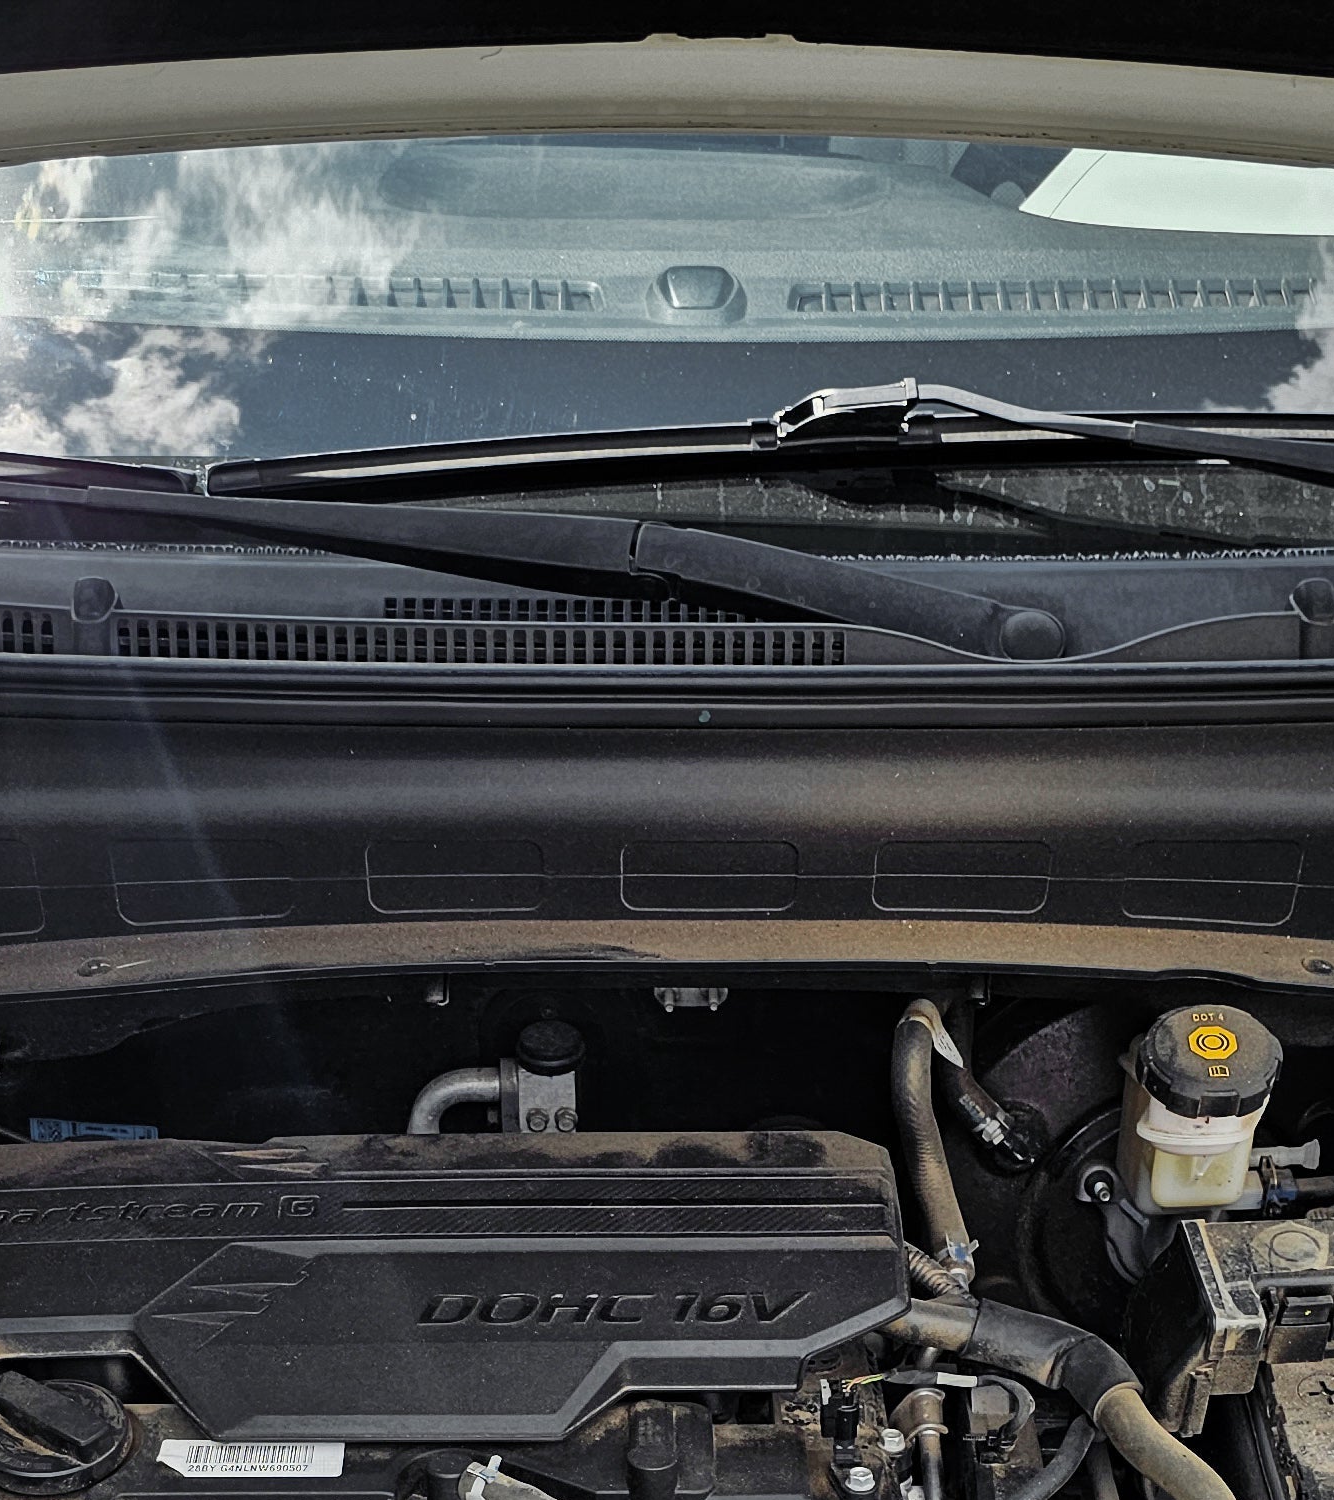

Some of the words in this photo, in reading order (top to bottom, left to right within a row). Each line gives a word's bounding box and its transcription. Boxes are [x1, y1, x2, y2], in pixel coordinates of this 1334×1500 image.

[1192, 1012, 1215, 1022] DOT
[417, 1292, 657, 1326] DOHC
[673, 1291, 812, 1324] 16V
